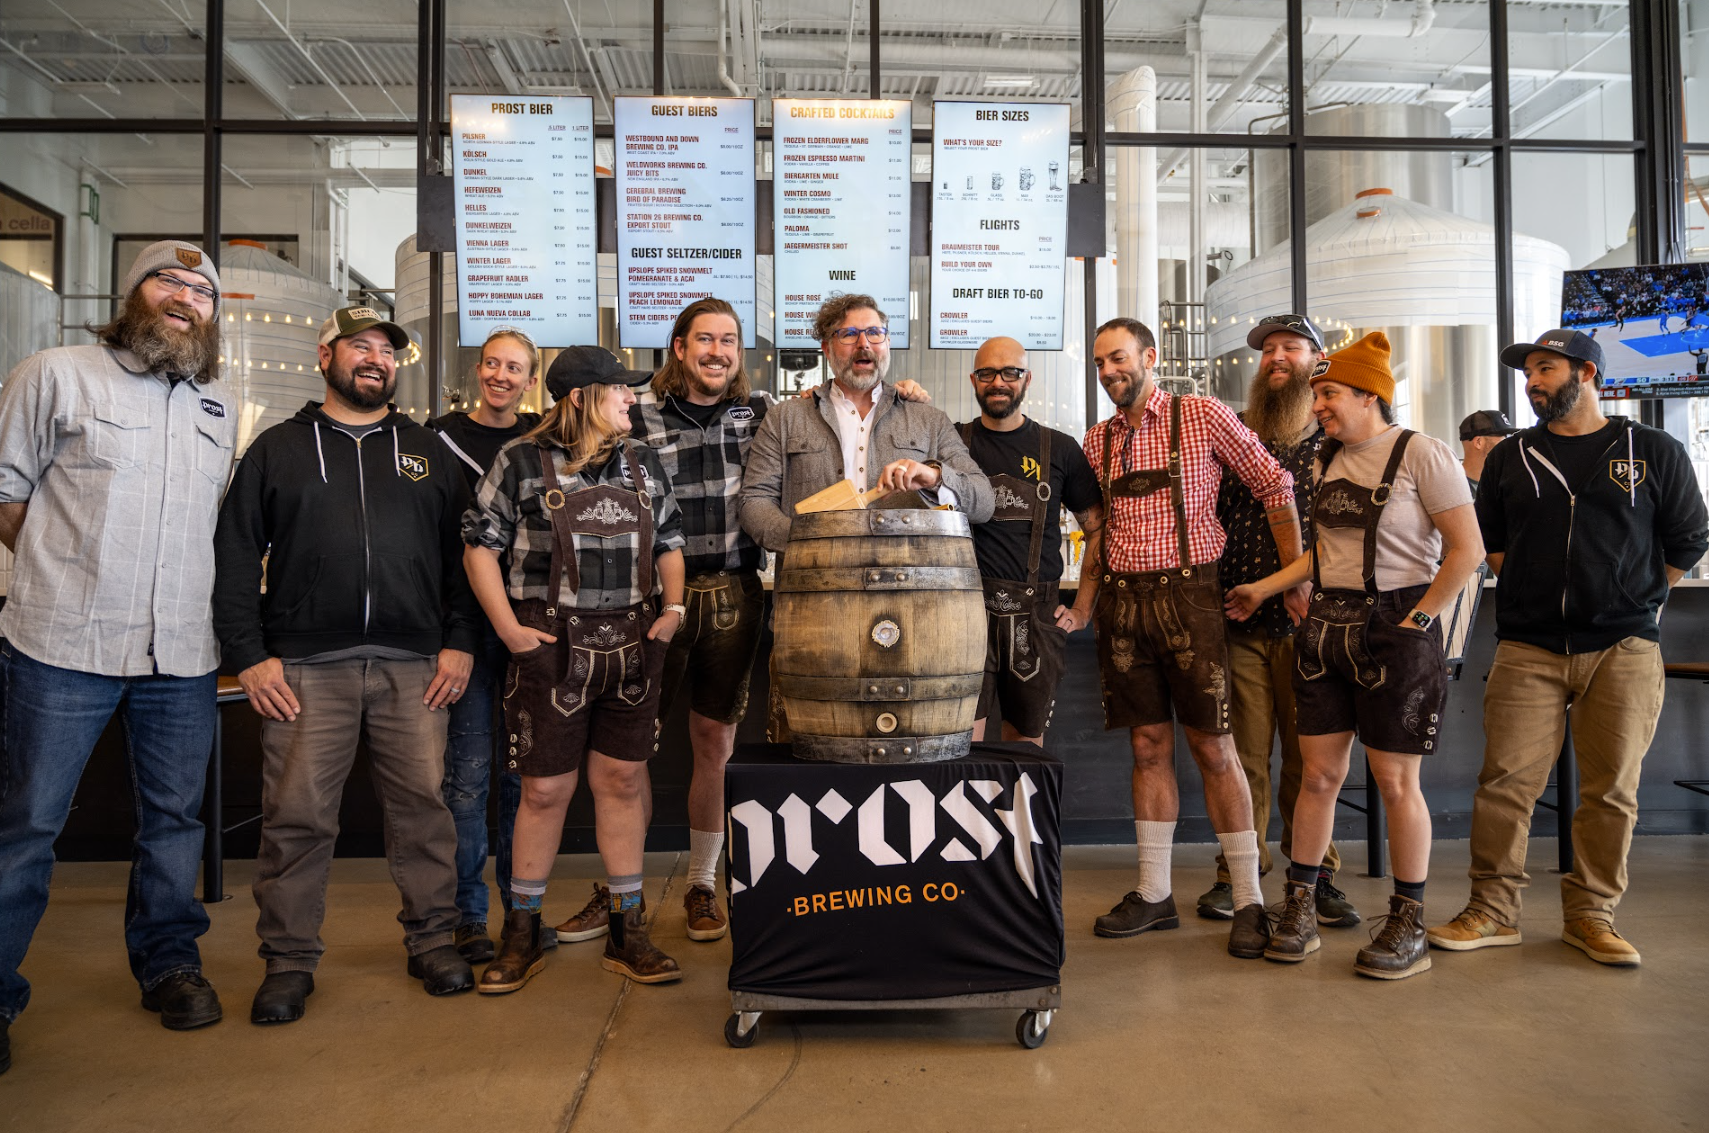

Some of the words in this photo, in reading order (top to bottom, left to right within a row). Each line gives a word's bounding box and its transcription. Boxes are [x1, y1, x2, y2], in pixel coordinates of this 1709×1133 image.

[492, 103, 525, 114] PROST
[530, 104, 553, 114] BIER
[652, 105, 684, 116] GUEST
[688, 106, 717, 117] BIERS
[790, 107, 835, 118] CRAFTED
[839, 108, 895, 119] COCKTAILS
[976, 110, 998, 121] BIER
[1002, 111, 1030, 121] SIZES
[463, 149, 487, 158] KÖLSCH
[980, 220, 1020, 230] FLIGHTS
[631, 248, 663, 259] GUEST
[667, 248, 742, 259] SELTZER/CIDER
[829, 270, 856, 280] WINE
[953, 288, 984, 299] DRAFT
[987, 289, 1009, 299] BIER
[1013, 289, 1043, 299] TO-GO
